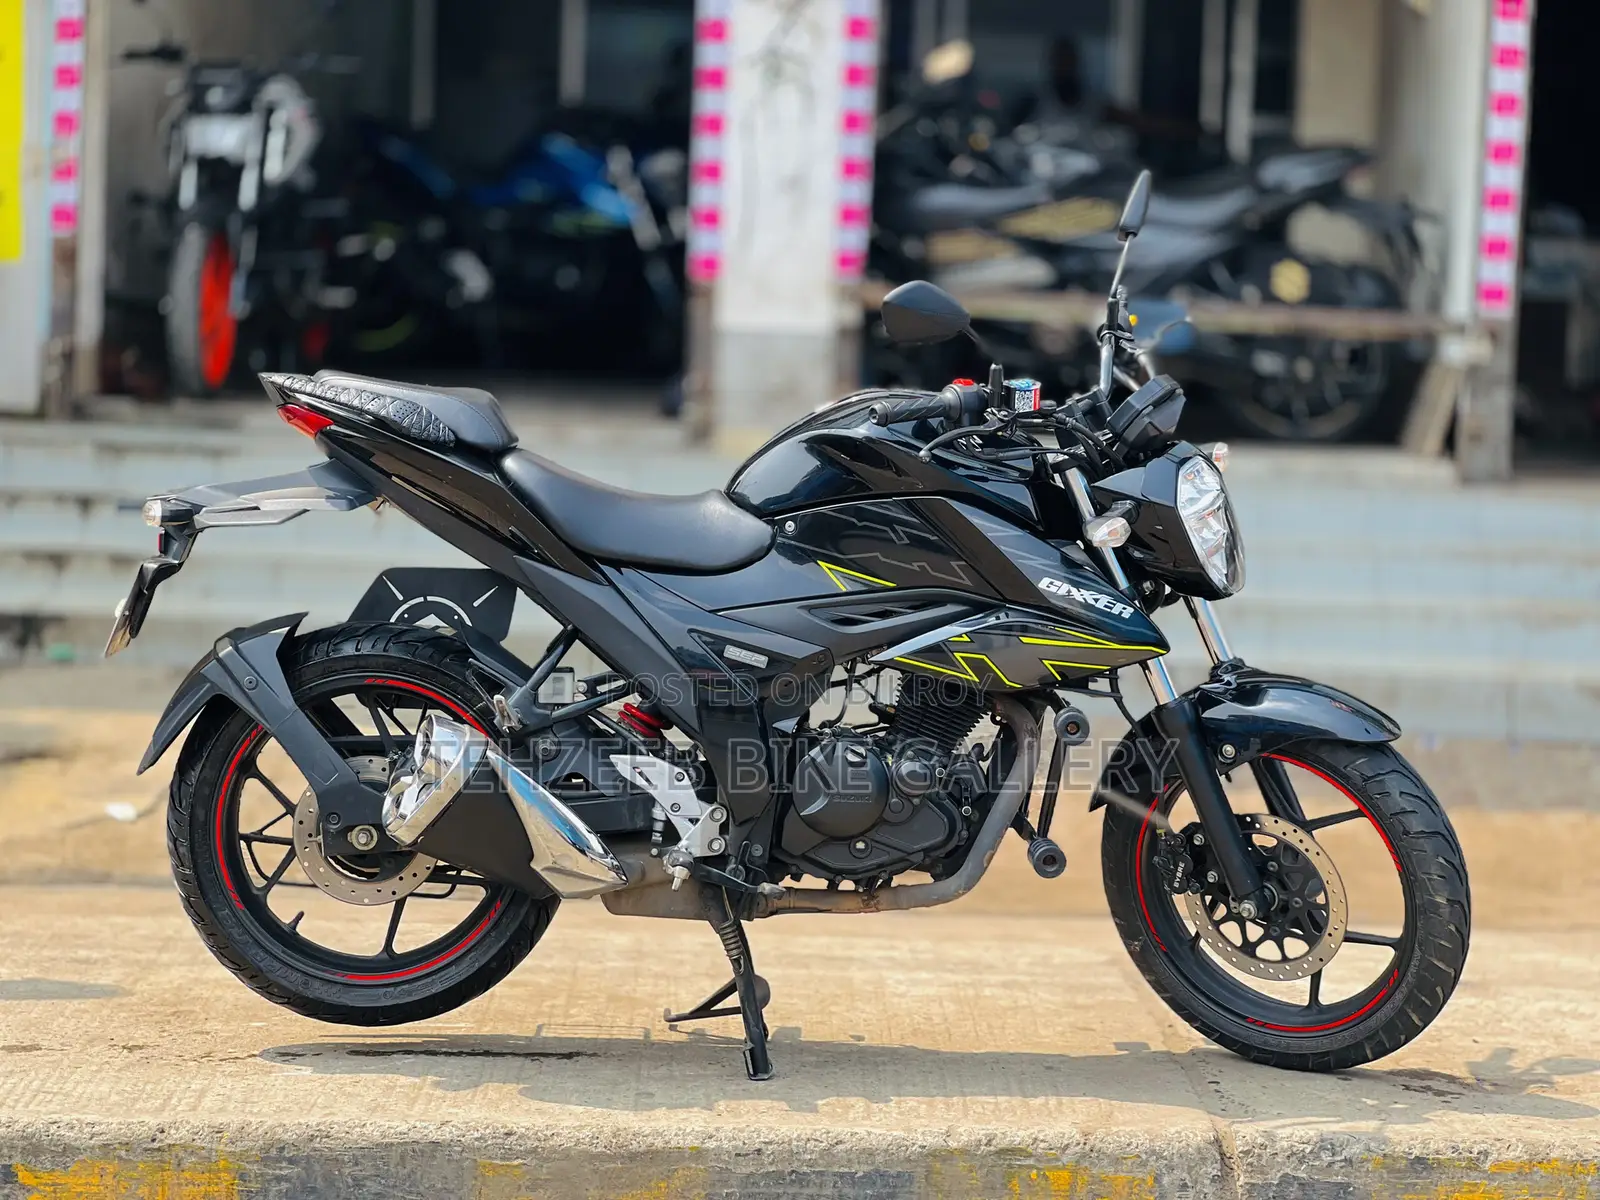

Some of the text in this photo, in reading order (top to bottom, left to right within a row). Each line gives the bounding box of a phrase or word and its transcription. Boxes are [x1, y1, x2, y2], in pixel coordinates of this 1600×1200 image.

[1038, 577, 1135, 619] GIXXER
[726, 646, 767, 665] SEP
[832, 795, 873, 803] SUZUKI
[1173, 861, 1185, 888] BYBRE
